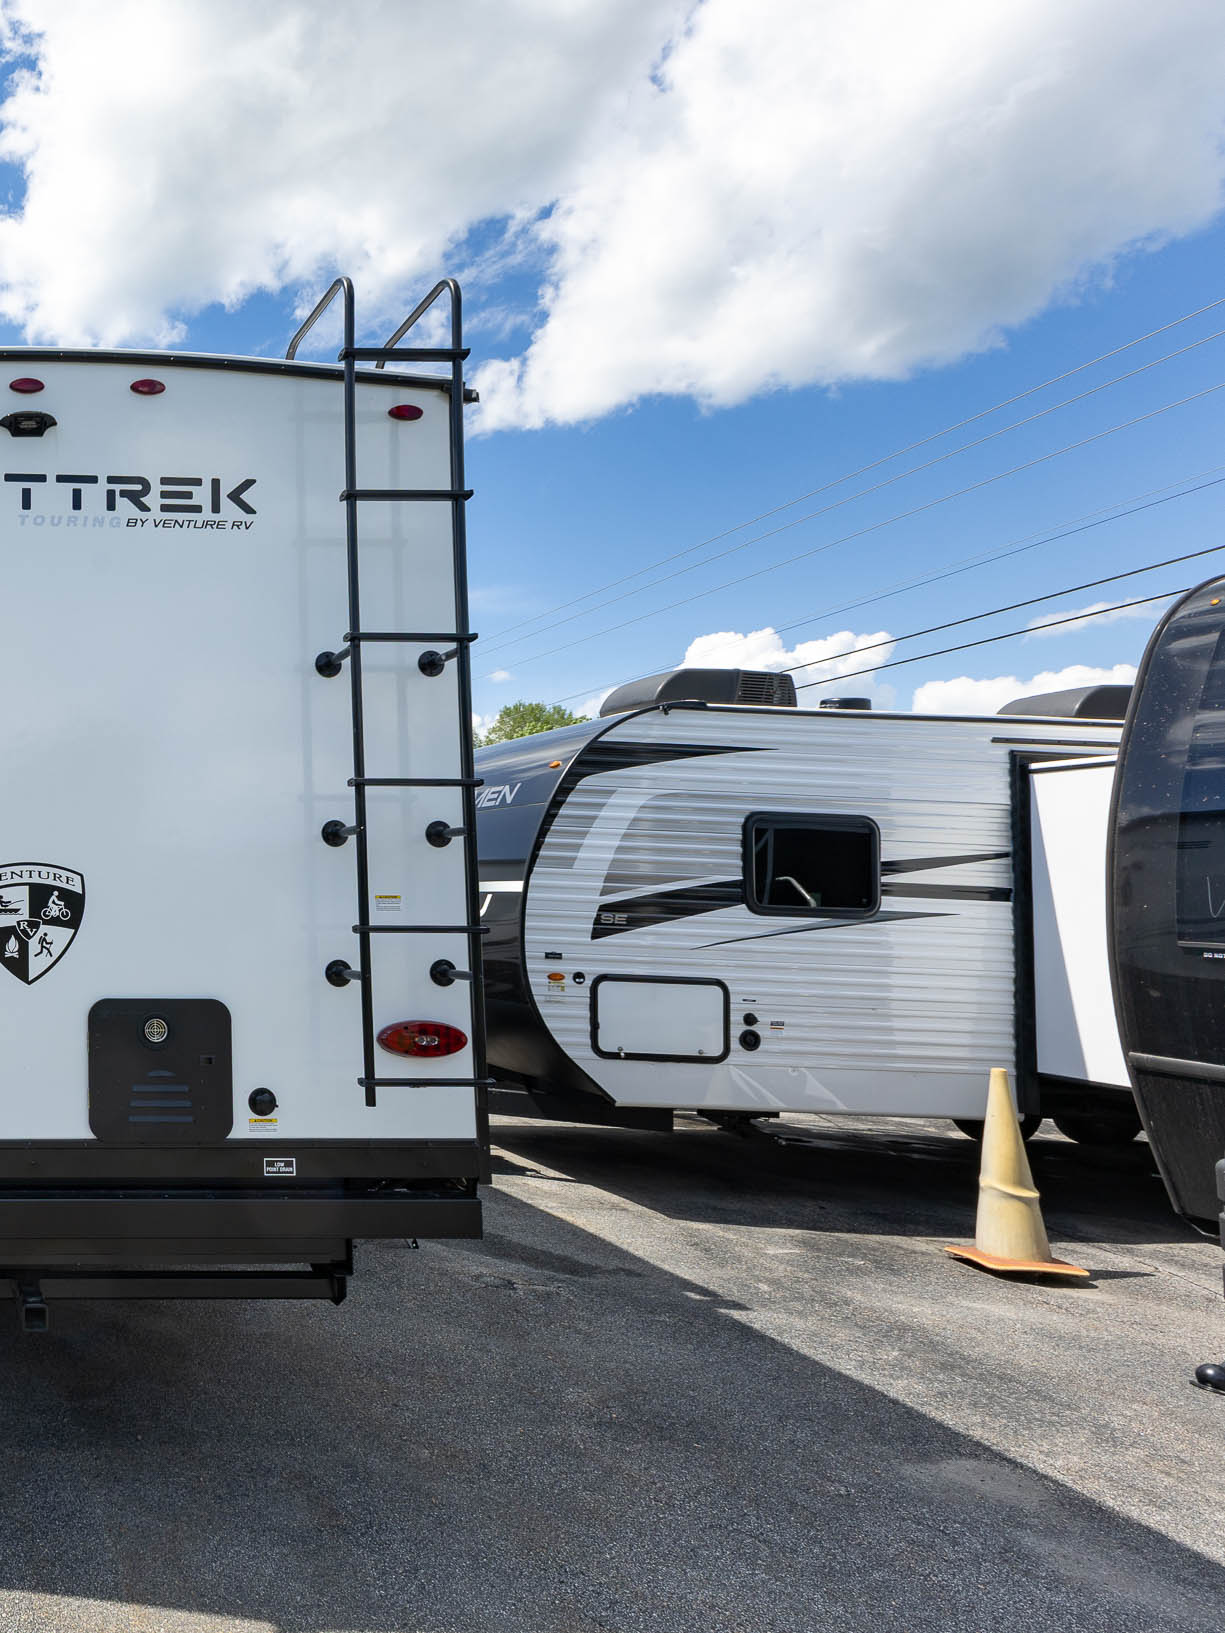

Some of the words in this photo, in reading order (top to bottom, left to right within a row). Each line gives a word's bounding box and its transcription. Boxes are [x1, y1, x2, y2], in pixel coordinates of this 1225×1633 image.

[17, 513, 123, 529] TOURING
[125, 517, 149, 528] BY
[152, 518, 228, 530] VENTURE
[230, 520, 254, 531] RV
[600, 912, 628, 924] SE
